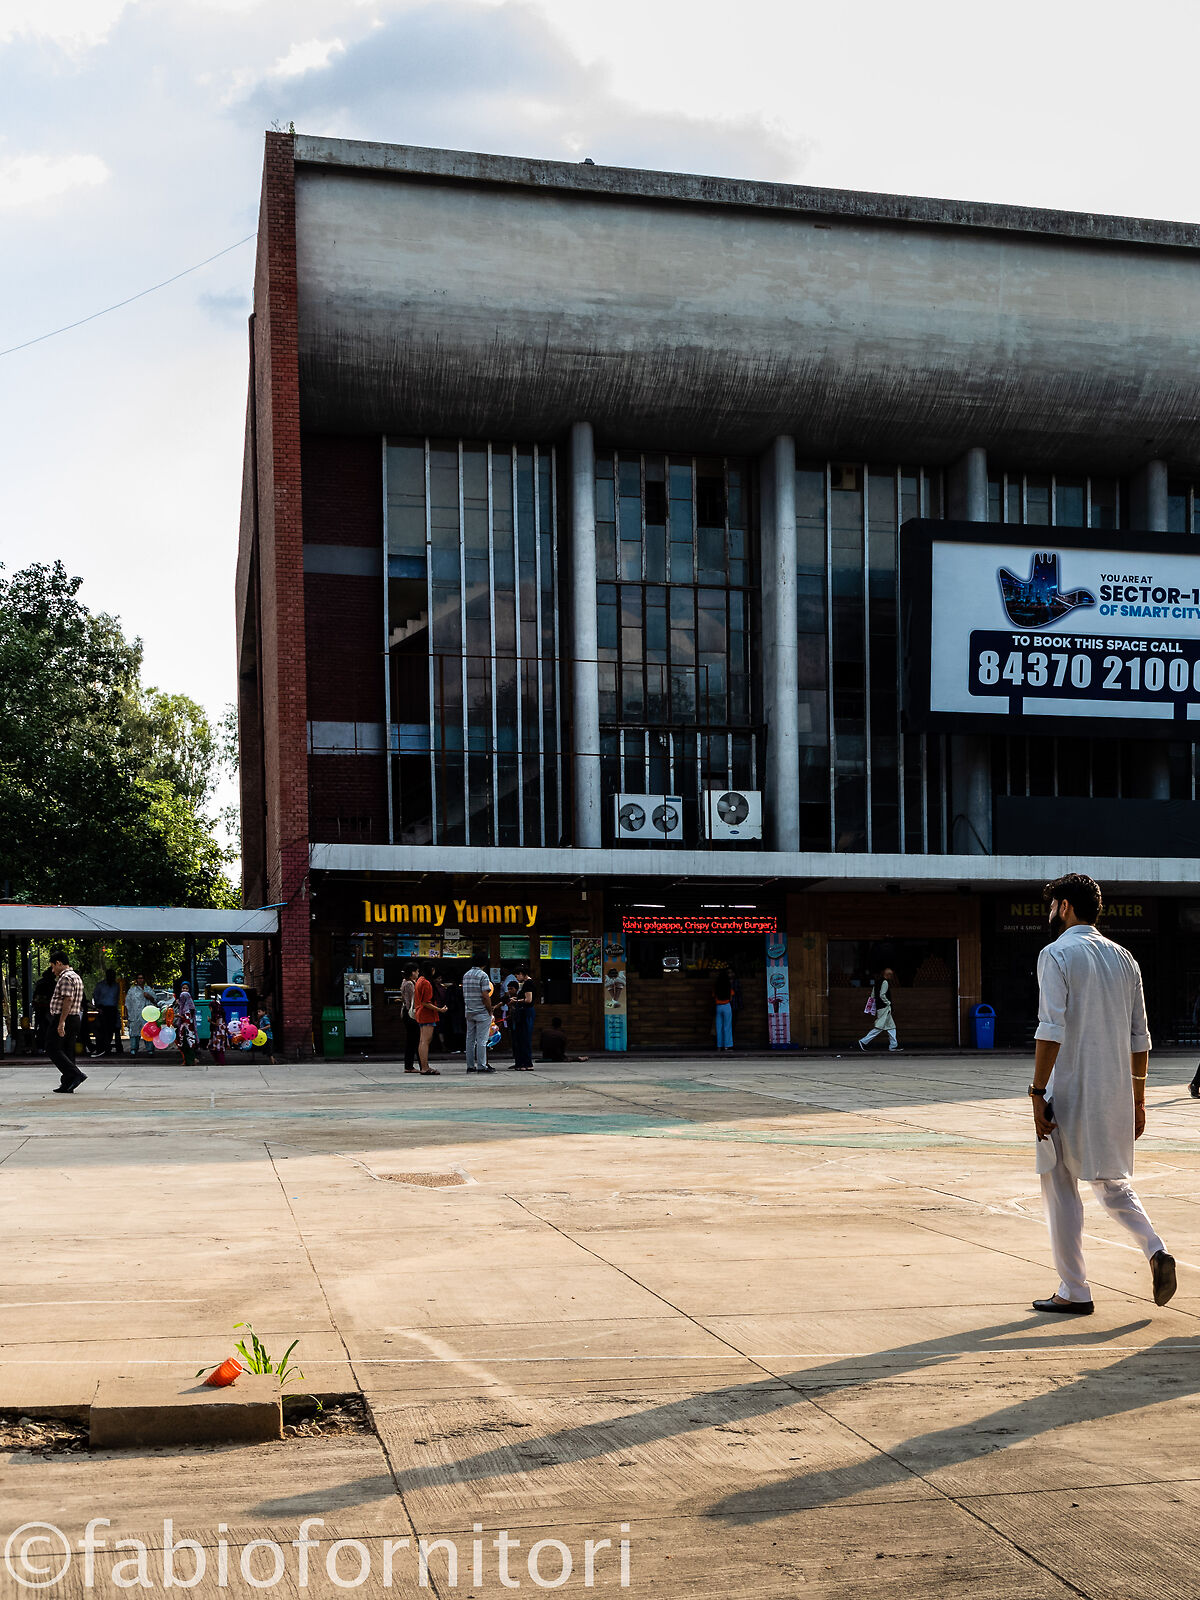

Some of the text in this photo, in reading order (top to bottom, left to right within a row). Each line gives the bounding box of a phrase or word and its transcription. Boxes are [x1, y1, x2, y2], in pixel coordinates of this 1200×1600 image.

[1100, 573, 1153, 584] YOU ARE AT
[1099, 604, 1119, 616] OF
[1120, 605, 1170, 618] SMART
[1012, 635, 1183, 653] TO BOOK THIS SPACE CALL
[978, 650, 1092, 688] 84370
[453, 899, 538, 928] Yummy
[684, 921, 709, 931] Crispy
[711, 921, 743, 931] Crunchy
